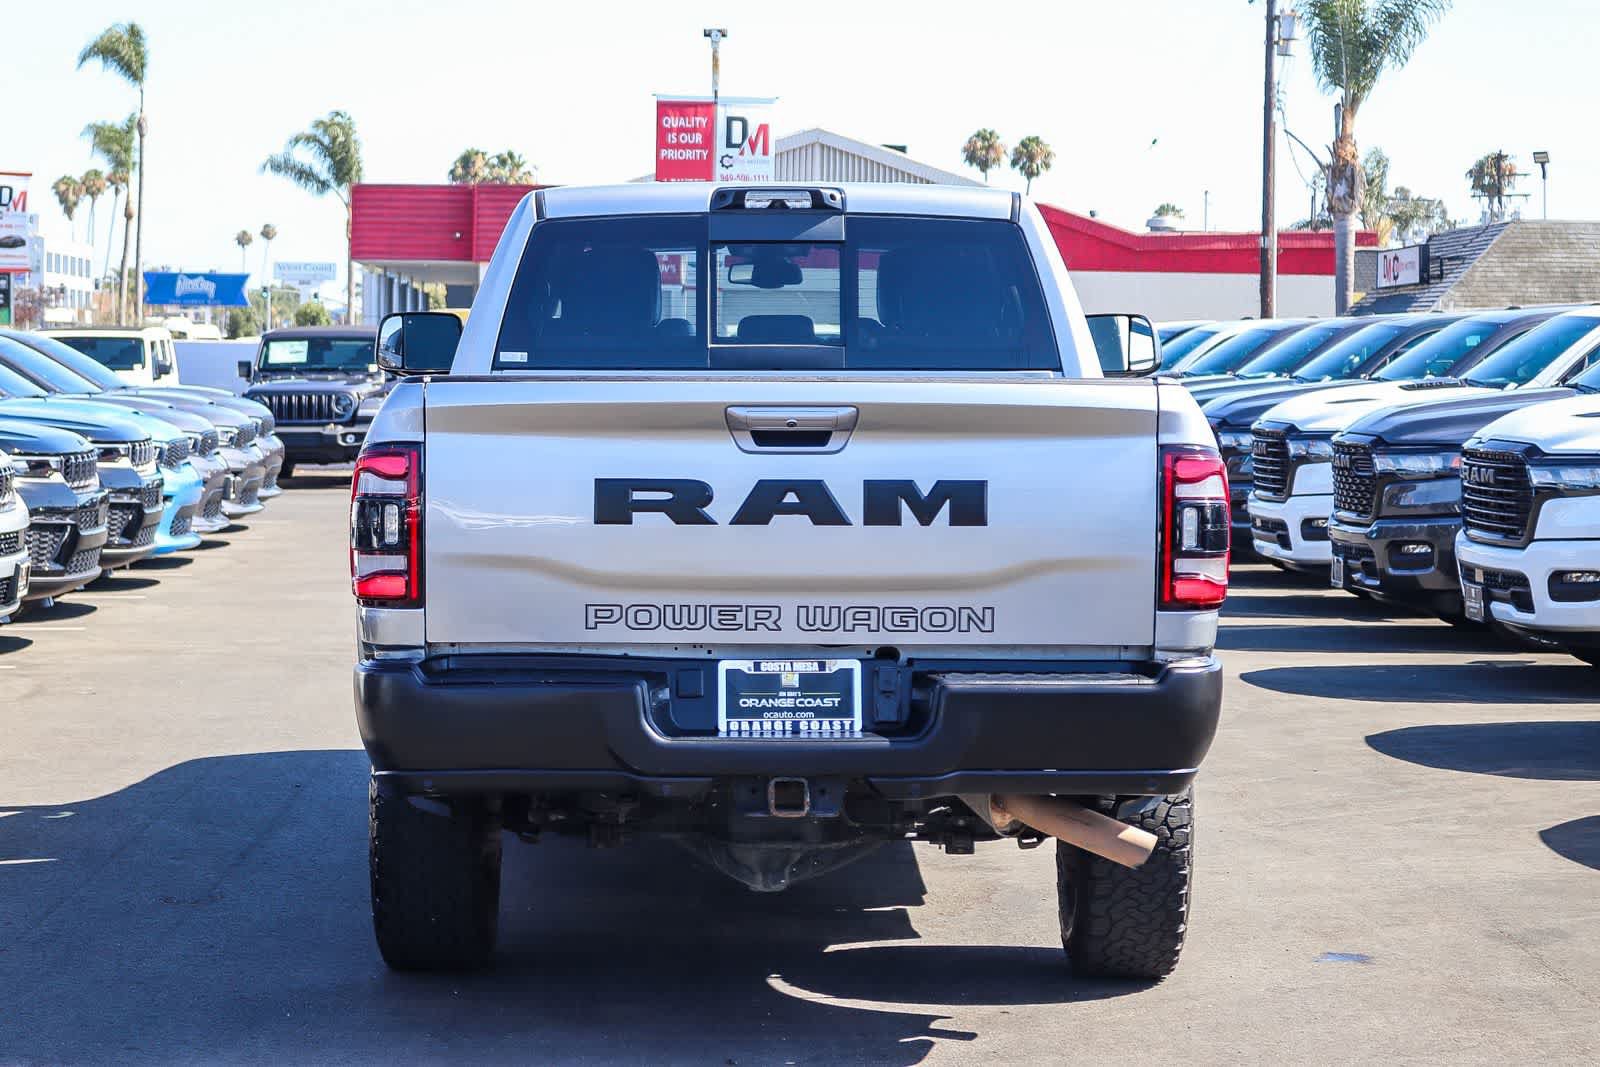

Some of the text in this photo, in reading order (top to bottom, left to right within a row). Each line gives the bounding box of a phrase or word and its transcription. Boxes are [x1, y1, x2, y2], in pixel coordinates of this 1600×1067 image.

[662, 115, 708, 129] QUALITY
[668, 132, 703, 145] IS OUR
[725, 116, 769, 157] DM
[661, 148, 709, 161] PRIORITY
[1460, 465, 1495, 484] RAM
[593, 477, 989, 527] RAM
[584, 603, 995, 633] POWER WAGON
[760, 661, 819, 672] COSTA MESA
[739, 697, 841, 708] ORANGE COAST
[763, 711, 815, 719] ocauto.com
[729, 720, 851, 731] ORANGE COAST
